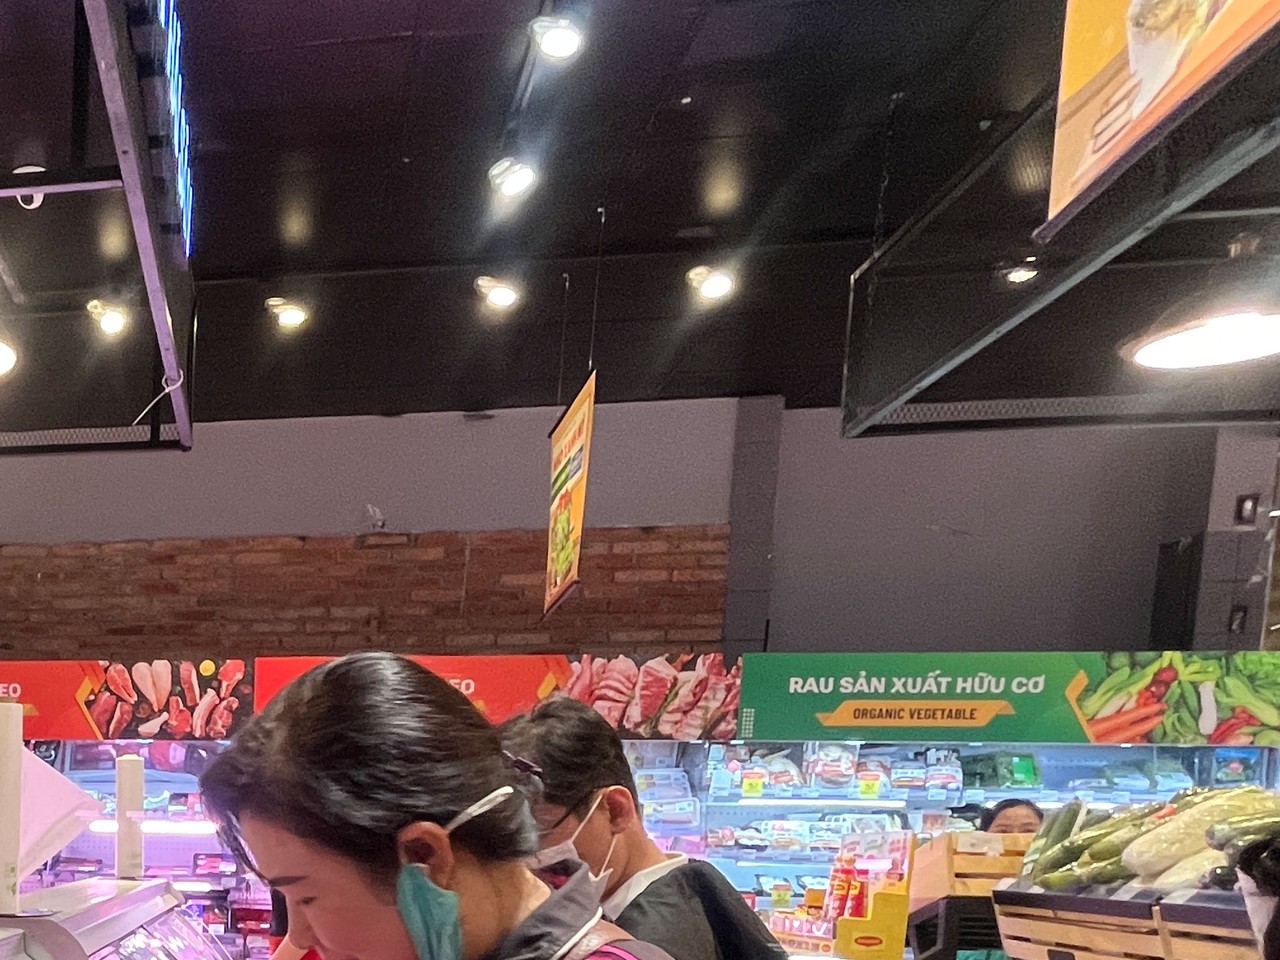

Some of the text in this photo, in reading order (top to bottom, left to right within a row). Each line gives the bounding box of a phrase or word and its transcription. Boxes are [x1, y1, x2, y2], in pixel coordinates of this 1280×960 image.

[789, 670, 1046, 694] RAU SẢN XUẤT HỮU CƠ
[853, 708, 977, 720] ORGANIC VEGETABLE
